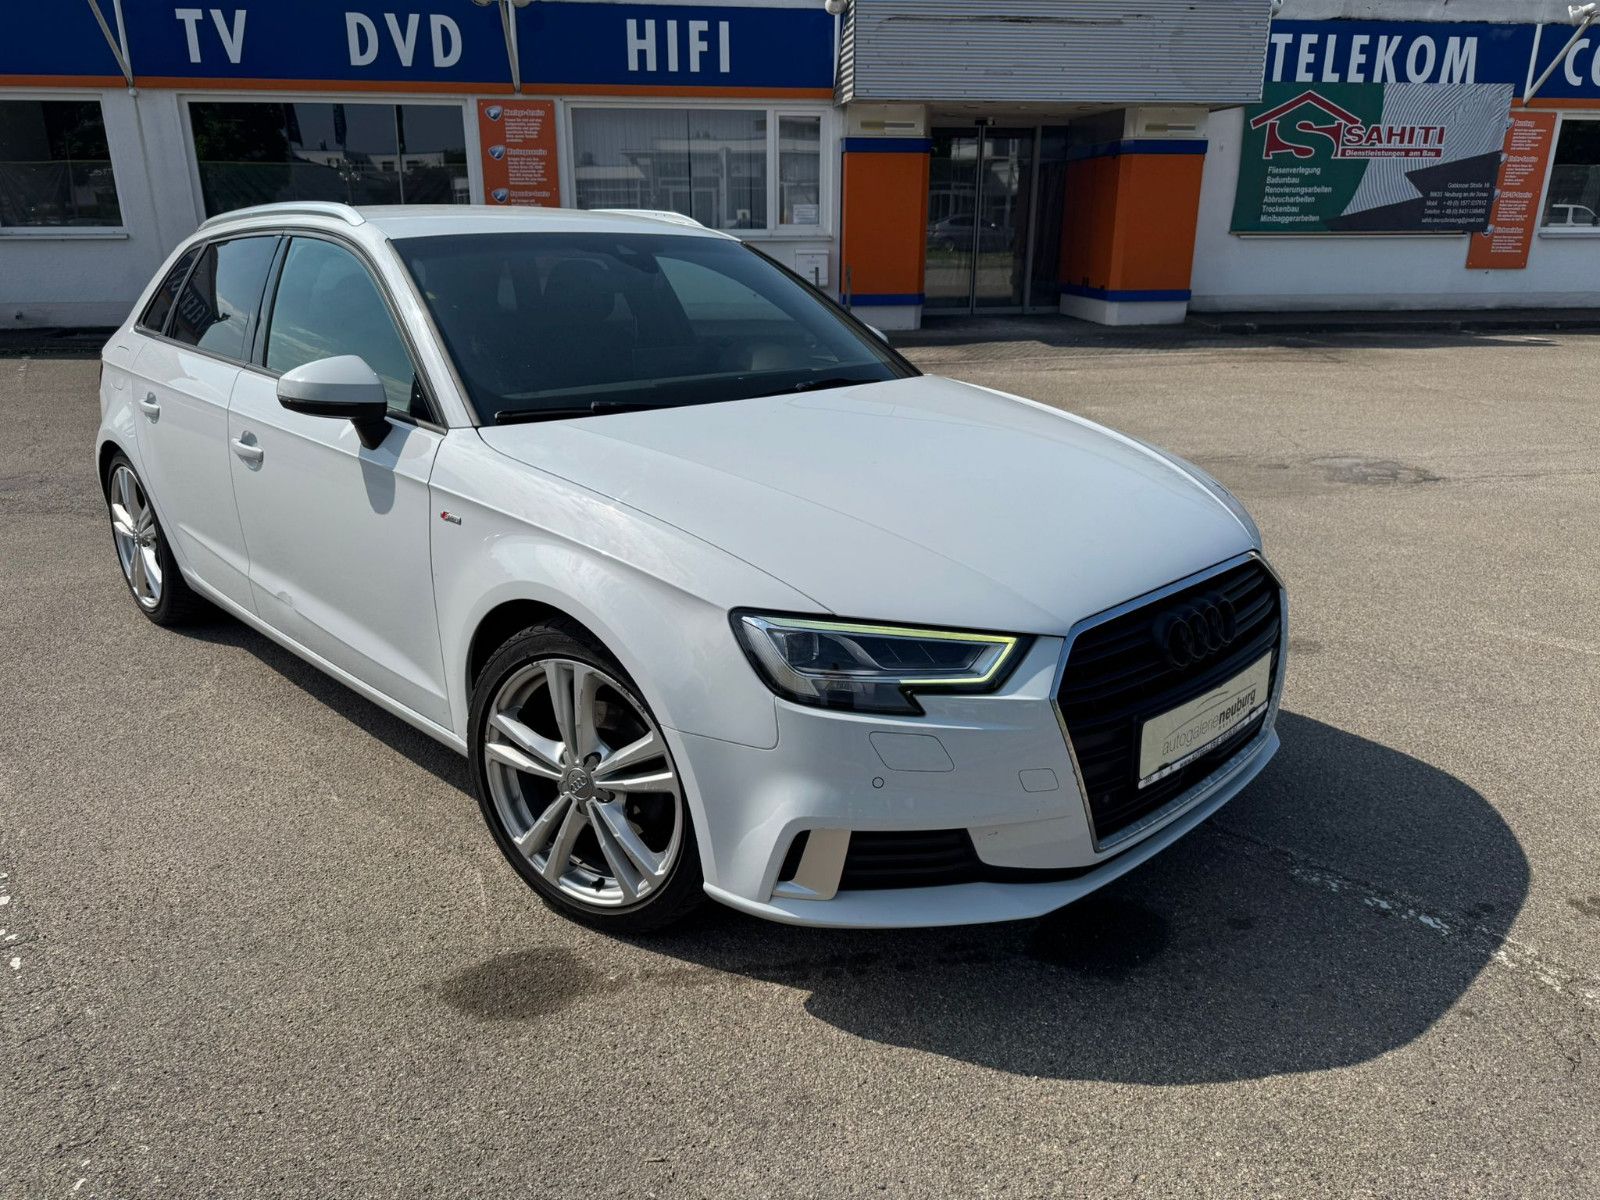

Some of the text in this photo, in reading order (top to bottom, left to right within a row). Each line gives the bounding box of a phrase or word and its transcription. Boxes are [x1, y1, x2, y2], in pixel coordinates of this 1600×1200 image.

[175, 8, 247, 63] TV
[345, 12, 462, 67] DVD
[626, 19, 730, 73] HIFI
[1270, 33, 1478, 84] TELEKOM
[1344, 125, 1446, 145] SAHITI
[1345, 149, 1405, 158] Dienstleistungen
[1422, 149, 1436, 157] Bau
[1267, 166, 1321, 175] Fliesenverlegung
[1266, 176, 1299, 184] Badumbau
[1264, 186, 1332, 195] Renovierungsarbeiten
[1263, 195, 1315, 203] Abbrucharbeiten
[1262, 205, 1300, 213] Trockenbau
[1260, 214, 1319, 223] Minibaggerarbeiten
